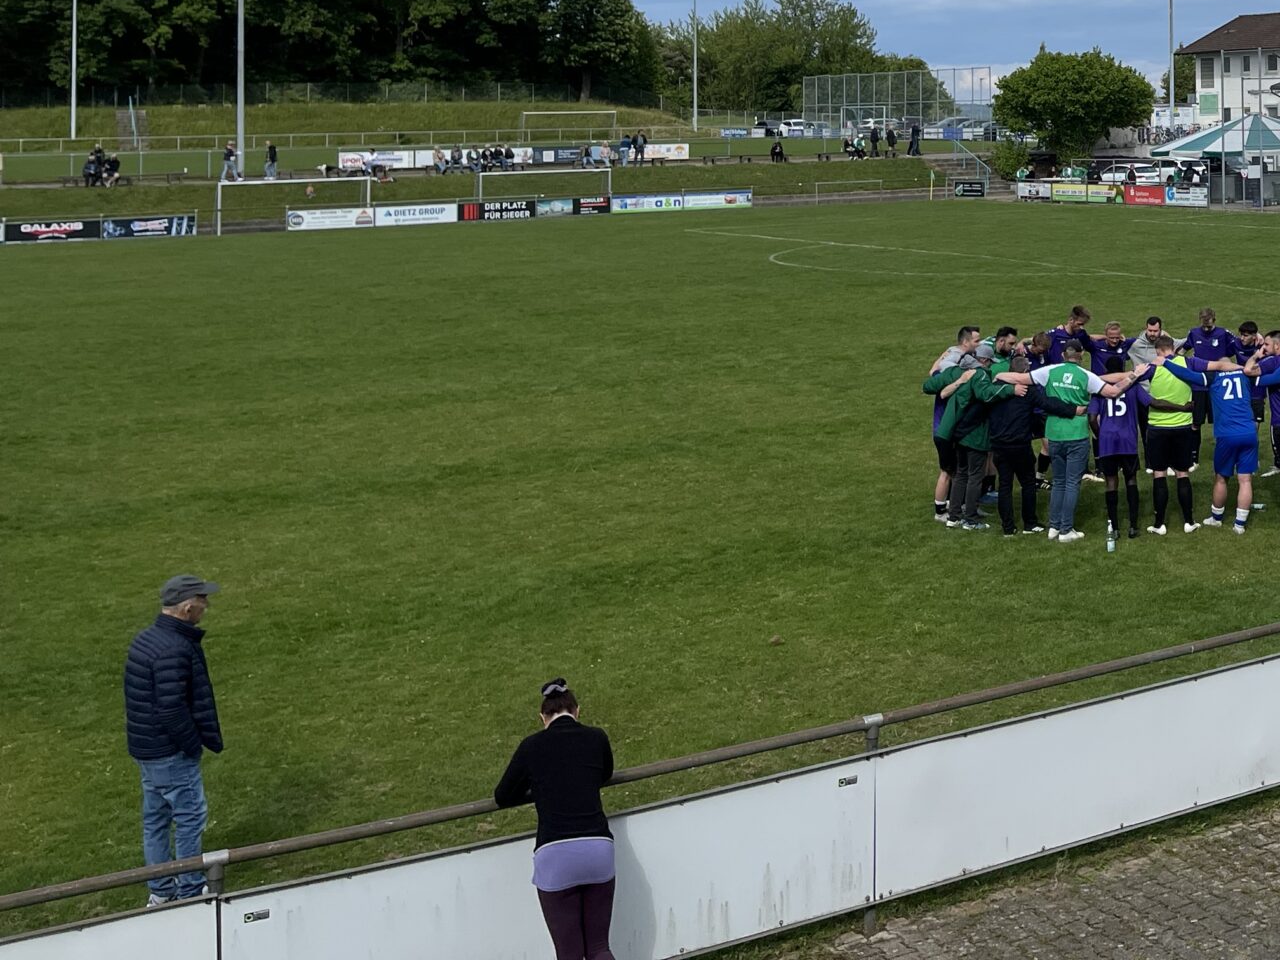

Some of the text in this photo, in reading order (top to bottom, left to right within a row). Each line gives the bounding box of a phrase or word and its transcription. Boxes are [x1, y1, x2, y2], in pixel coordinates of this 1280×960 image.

[484, 201, 527, 211] DER PLATZ
[394, 207, 446, 217] DIETZ GROUP
[484, 210, 531, 220] FÜR SIEGER
[20, 221, 84, 233] GALAXIS
[1222, 377, 1243, 400] 21
[1106, 393, 1127, 417] 15
